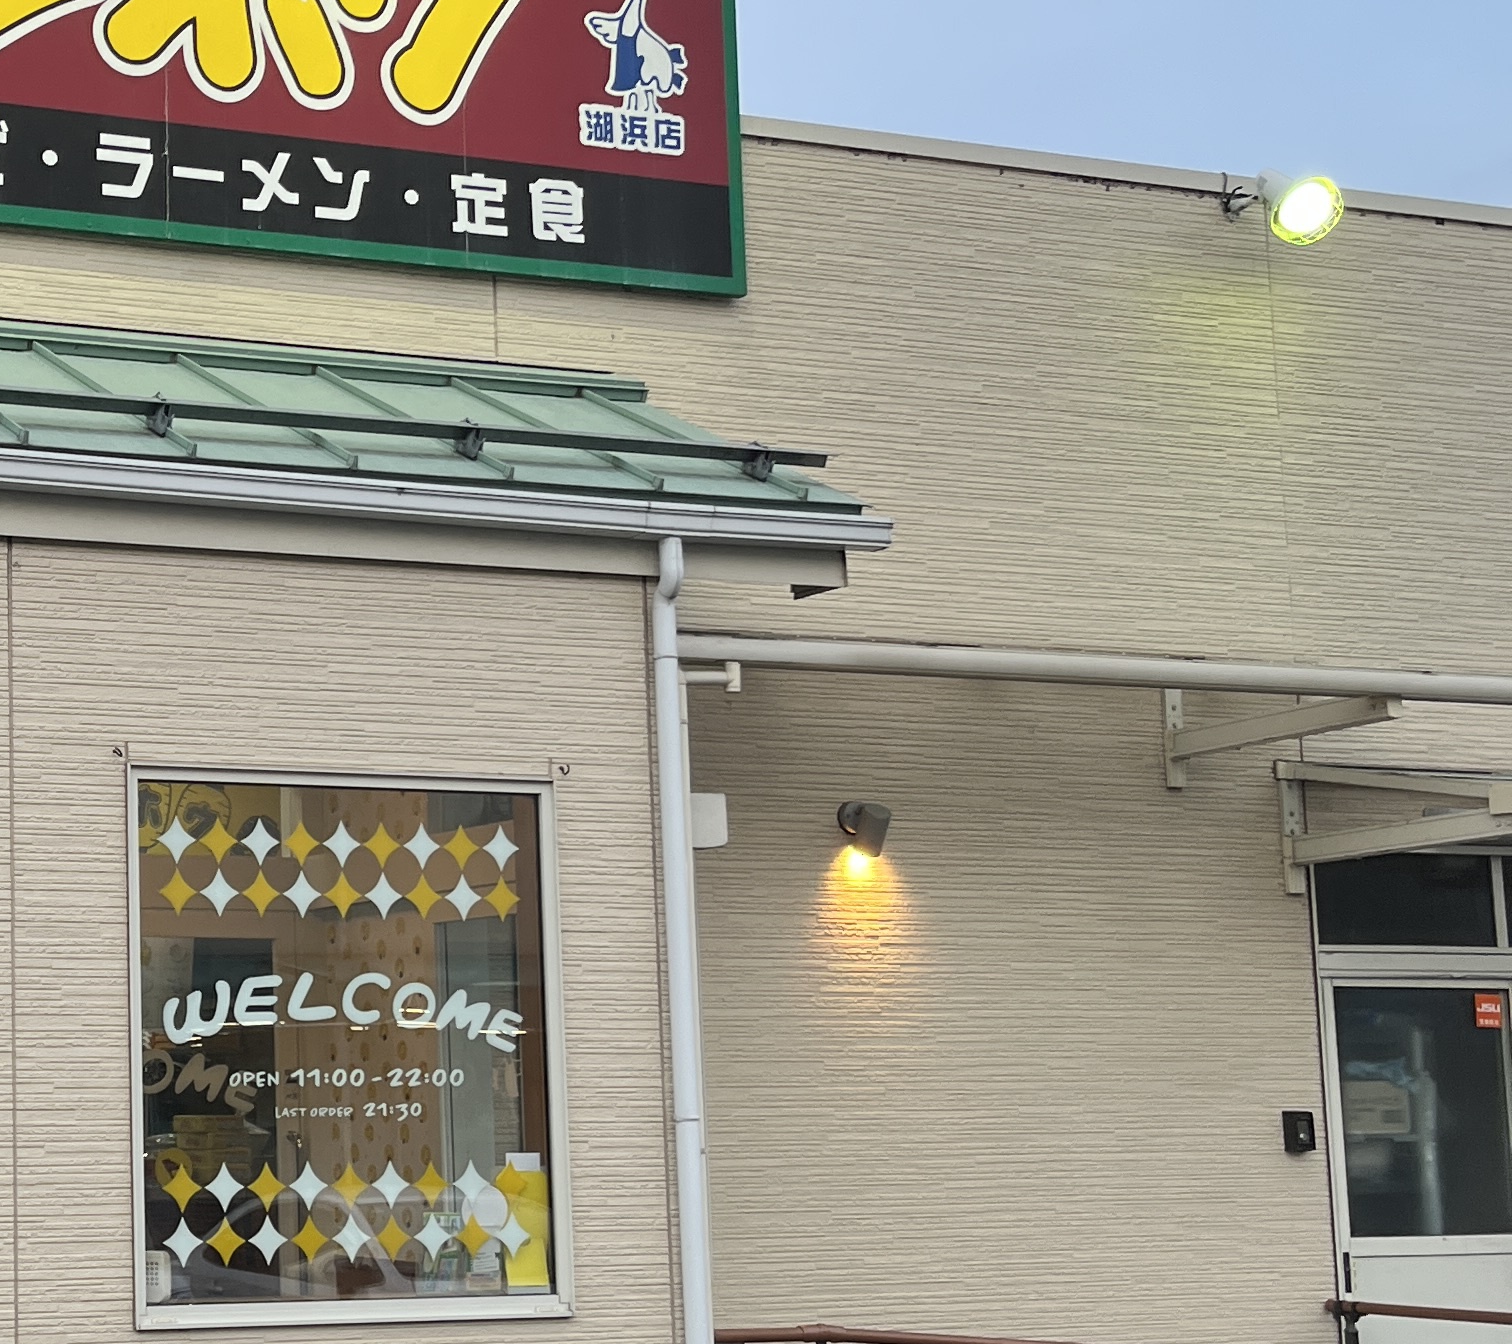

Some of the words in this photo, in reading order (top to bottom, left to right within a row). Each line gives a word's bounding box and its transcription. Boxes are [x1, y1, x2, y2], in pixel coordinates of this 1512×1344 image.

[585, 110, 681, 150] 湖浜店
[163, 971, 524, 1054] WELCOME
[229, 1070, 280, 1088] OPEN
[275, 1105, 307, 1119] LAST
[310, 1106, 354, 1119] ORDER
[363, 1102, 423, 1122] 21:30
